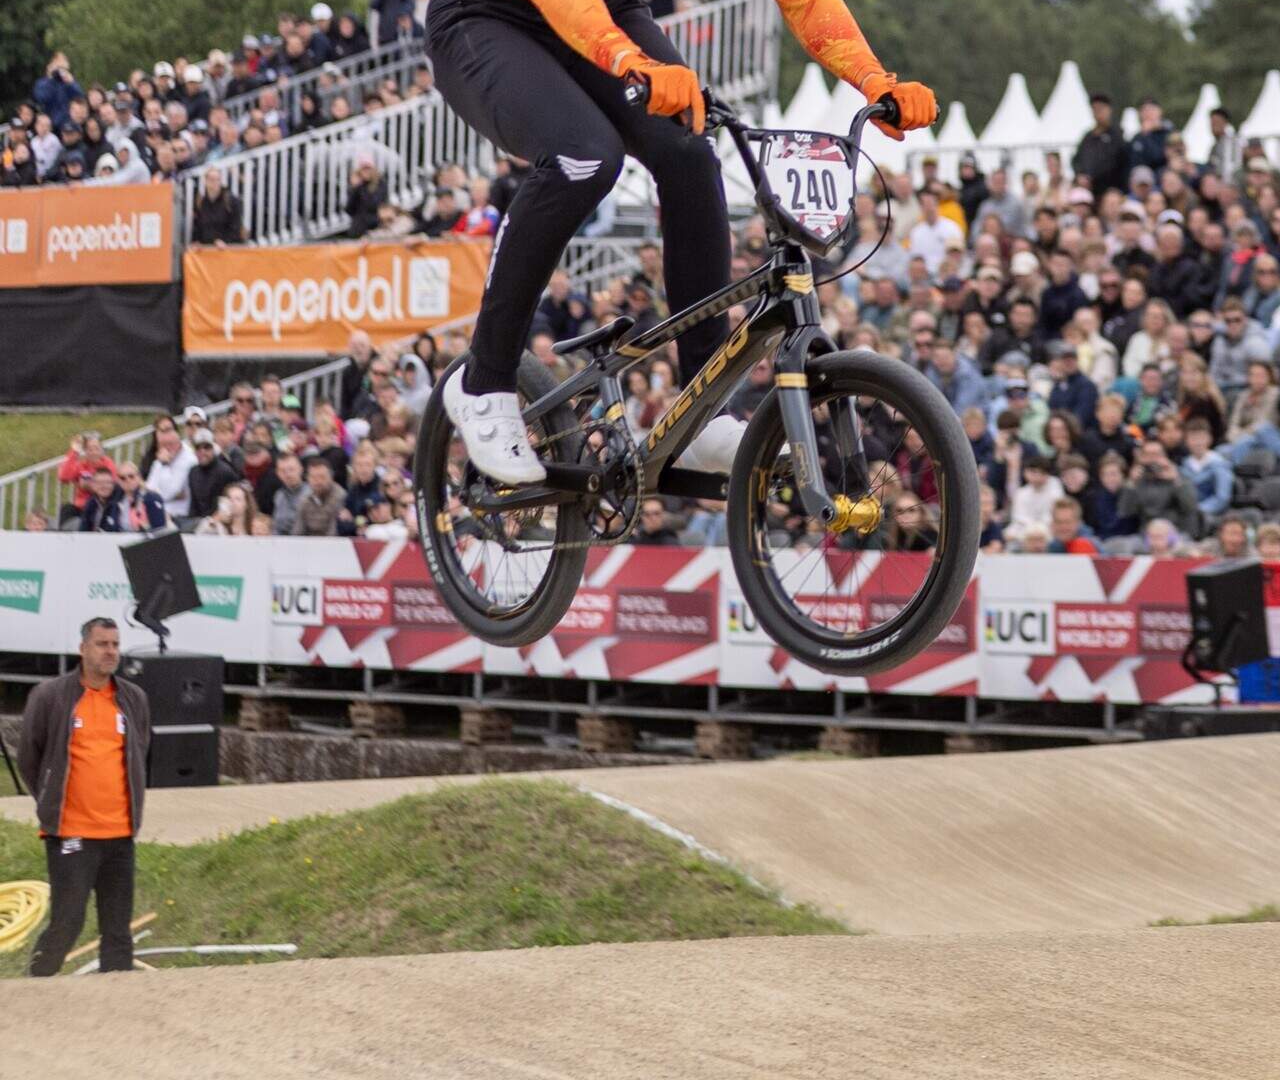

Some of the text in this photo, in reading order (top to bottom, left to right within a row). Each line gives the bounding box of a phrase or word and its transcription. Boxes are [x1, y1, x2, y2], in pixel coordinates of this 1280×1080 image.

[786, 167, 838, 212] 240
[47, 212, 139, 262] papendal
[223, 255, 403, 342] papendal
[279, 586, 318, 615] UCI
[997, 611, 1048, 643] UCI
